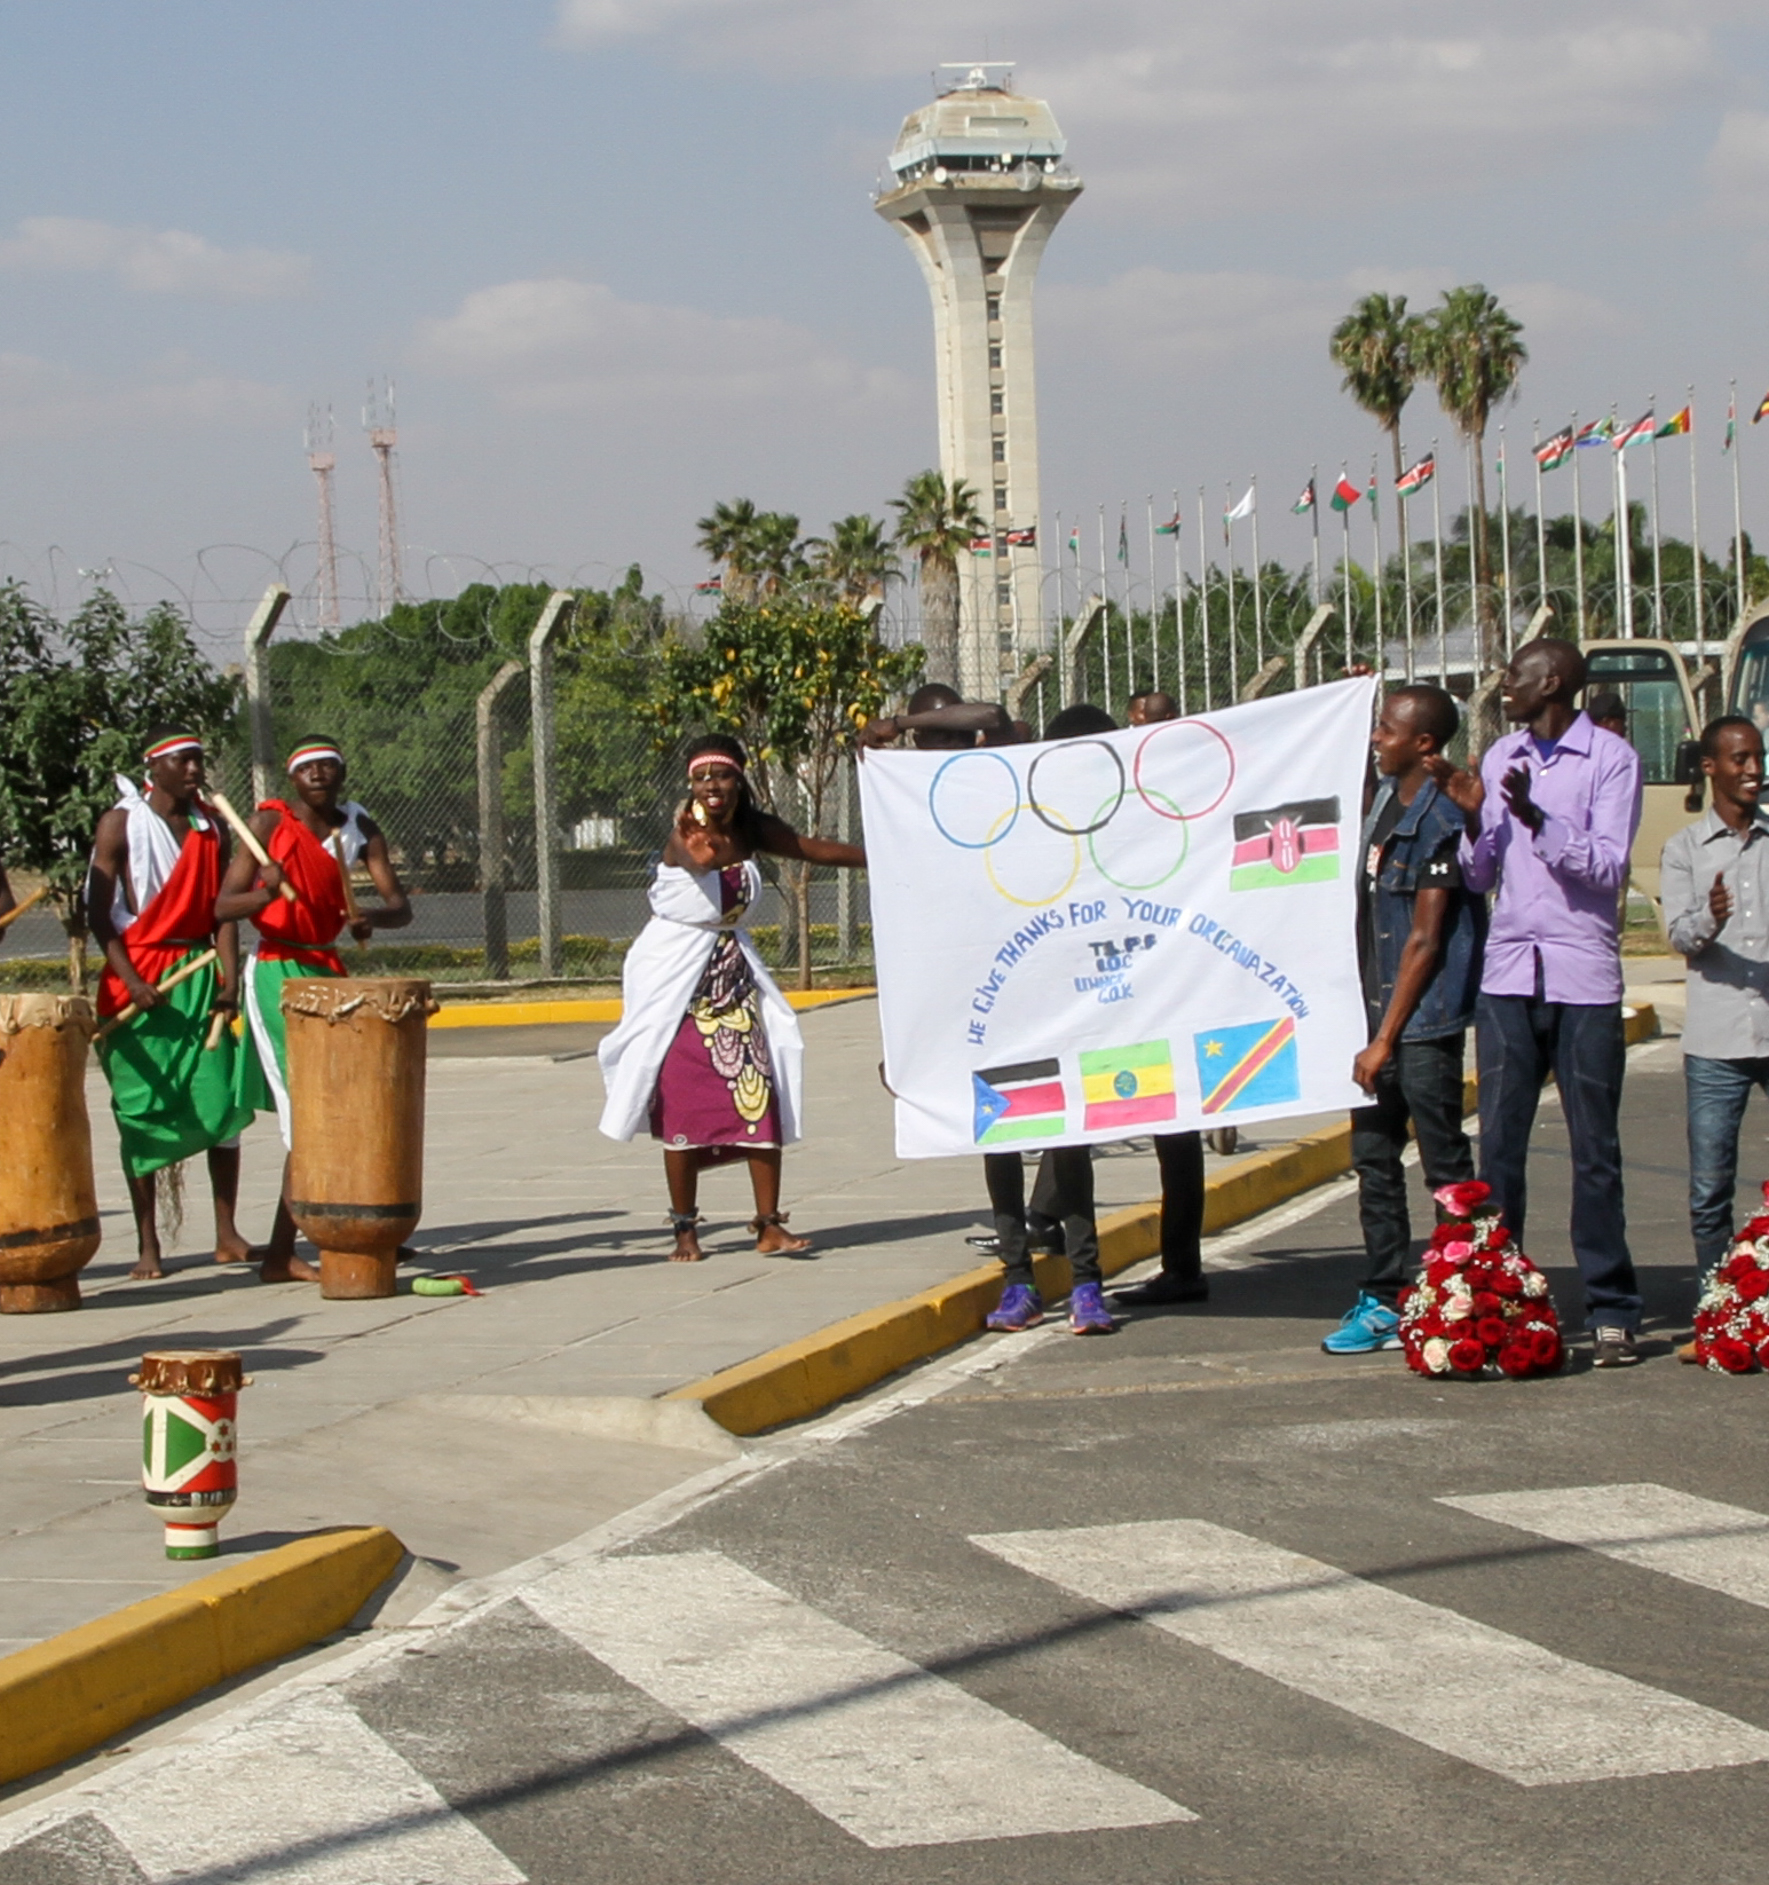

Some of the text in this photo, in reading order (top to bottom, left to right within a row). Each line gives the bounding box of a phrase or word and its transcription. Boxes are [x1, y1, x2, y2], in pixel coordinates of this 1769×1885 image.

[966, 1019, 987, 1045] WE
[994, 909, 1065, 969] THANKS
[1068, 900, 1107, 927] FOR
[1120, 896, 1182, 928] YOUR
